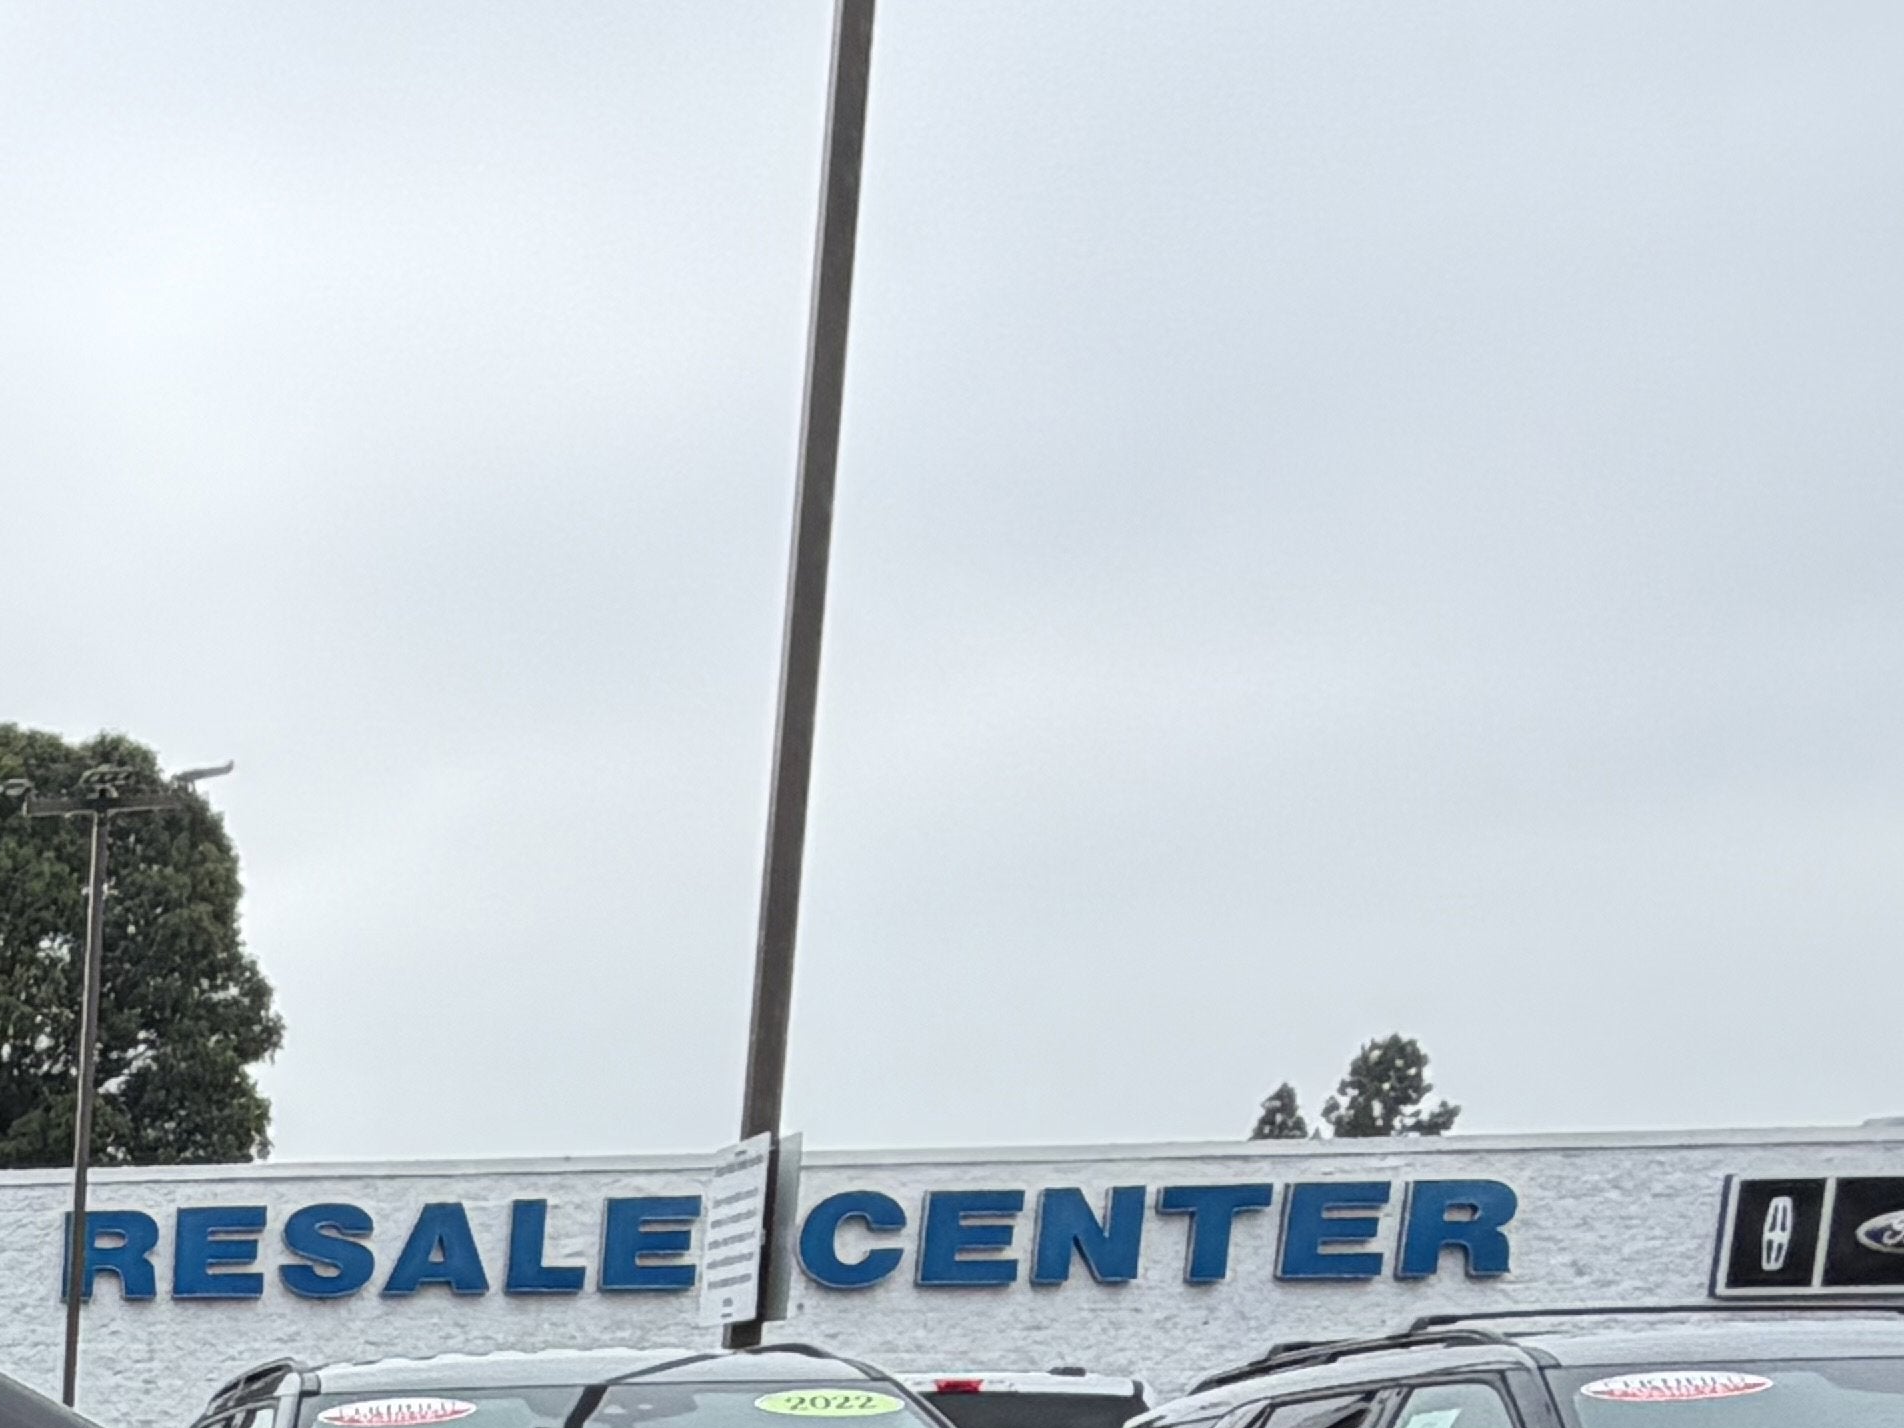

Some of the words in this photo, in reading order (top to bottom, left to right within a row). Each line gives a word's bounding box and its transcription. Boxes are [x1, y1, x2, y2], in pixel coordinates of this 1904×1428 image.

[63, 1195, 702, 1300] RESALE
[799, 1179, 1519, 1289] CENTER
[785, 1395, 877, 1411] 2022
